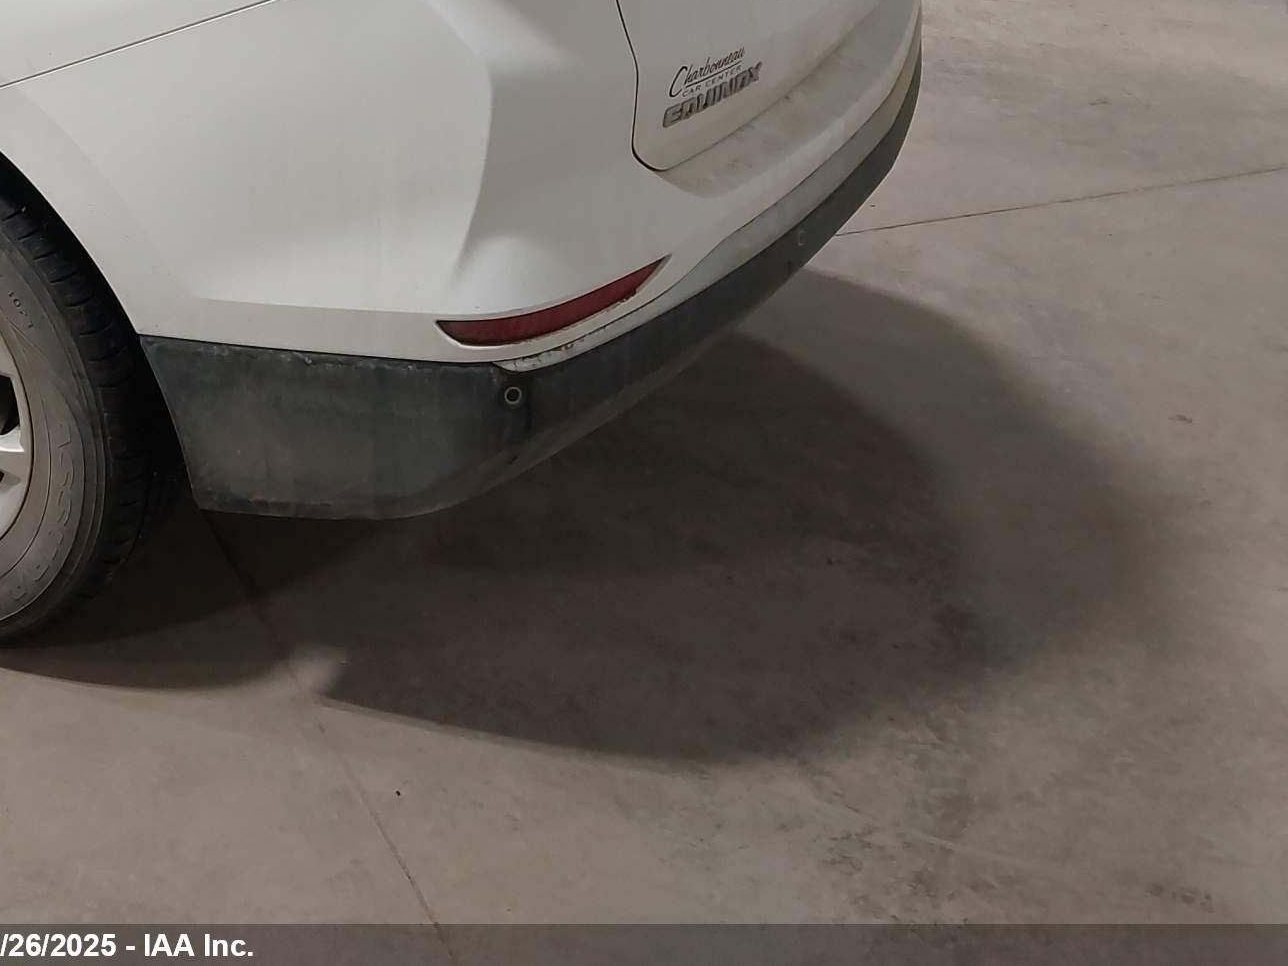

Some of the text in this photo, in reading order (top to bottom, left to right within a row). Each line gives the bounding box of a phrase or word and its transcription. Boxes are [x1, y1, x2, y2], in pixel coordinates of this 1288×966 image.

[662, 61, 763, 128] EQUINOX
[669, 46, 745, 98] Charbonneau
[682, 64, 742, 98] CAR CENTER
